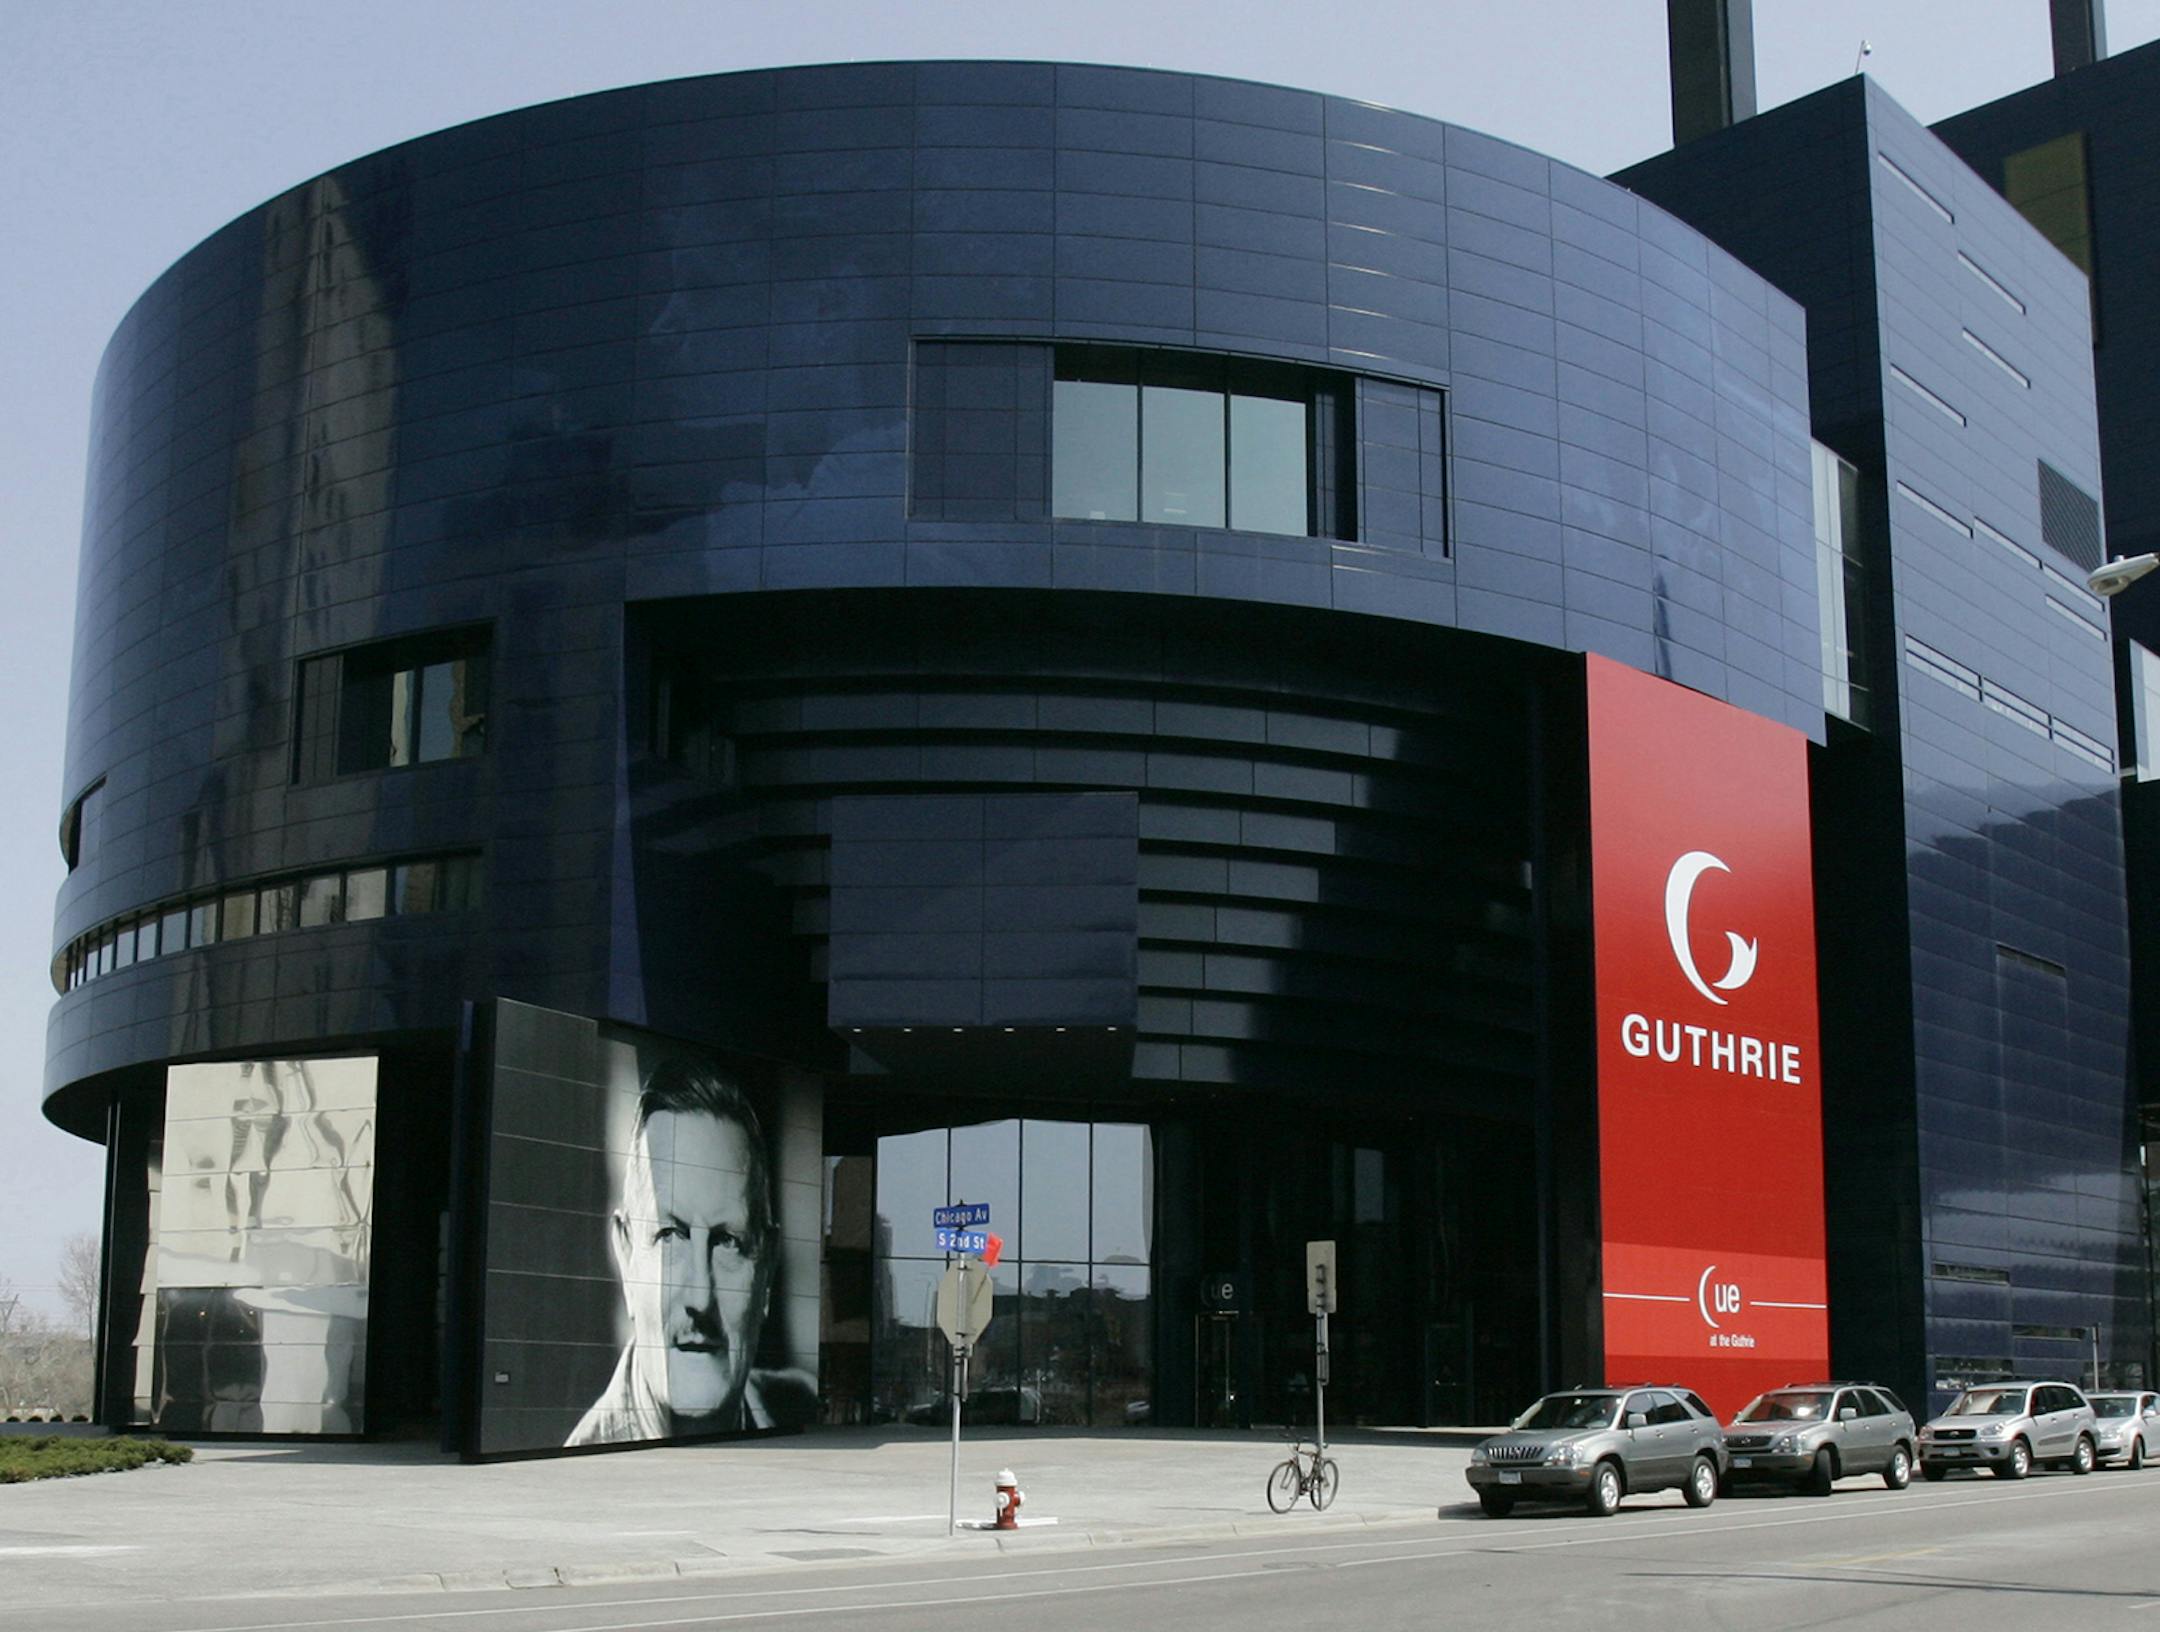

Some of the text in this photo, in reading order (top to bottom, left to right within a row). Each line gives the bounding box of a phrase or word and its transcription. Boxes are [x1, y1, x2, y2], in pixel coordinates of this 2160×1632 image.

[1621, 1013, 1802, 1085] GUTHRIE
[935, 1208, 988, 1225] Chicago Av
[938, 1232, 985, 1249] S 2nd St
[1719, 1334, 1730, 1347] the
[1731, 1334, 1755, 1348] Guthrie
